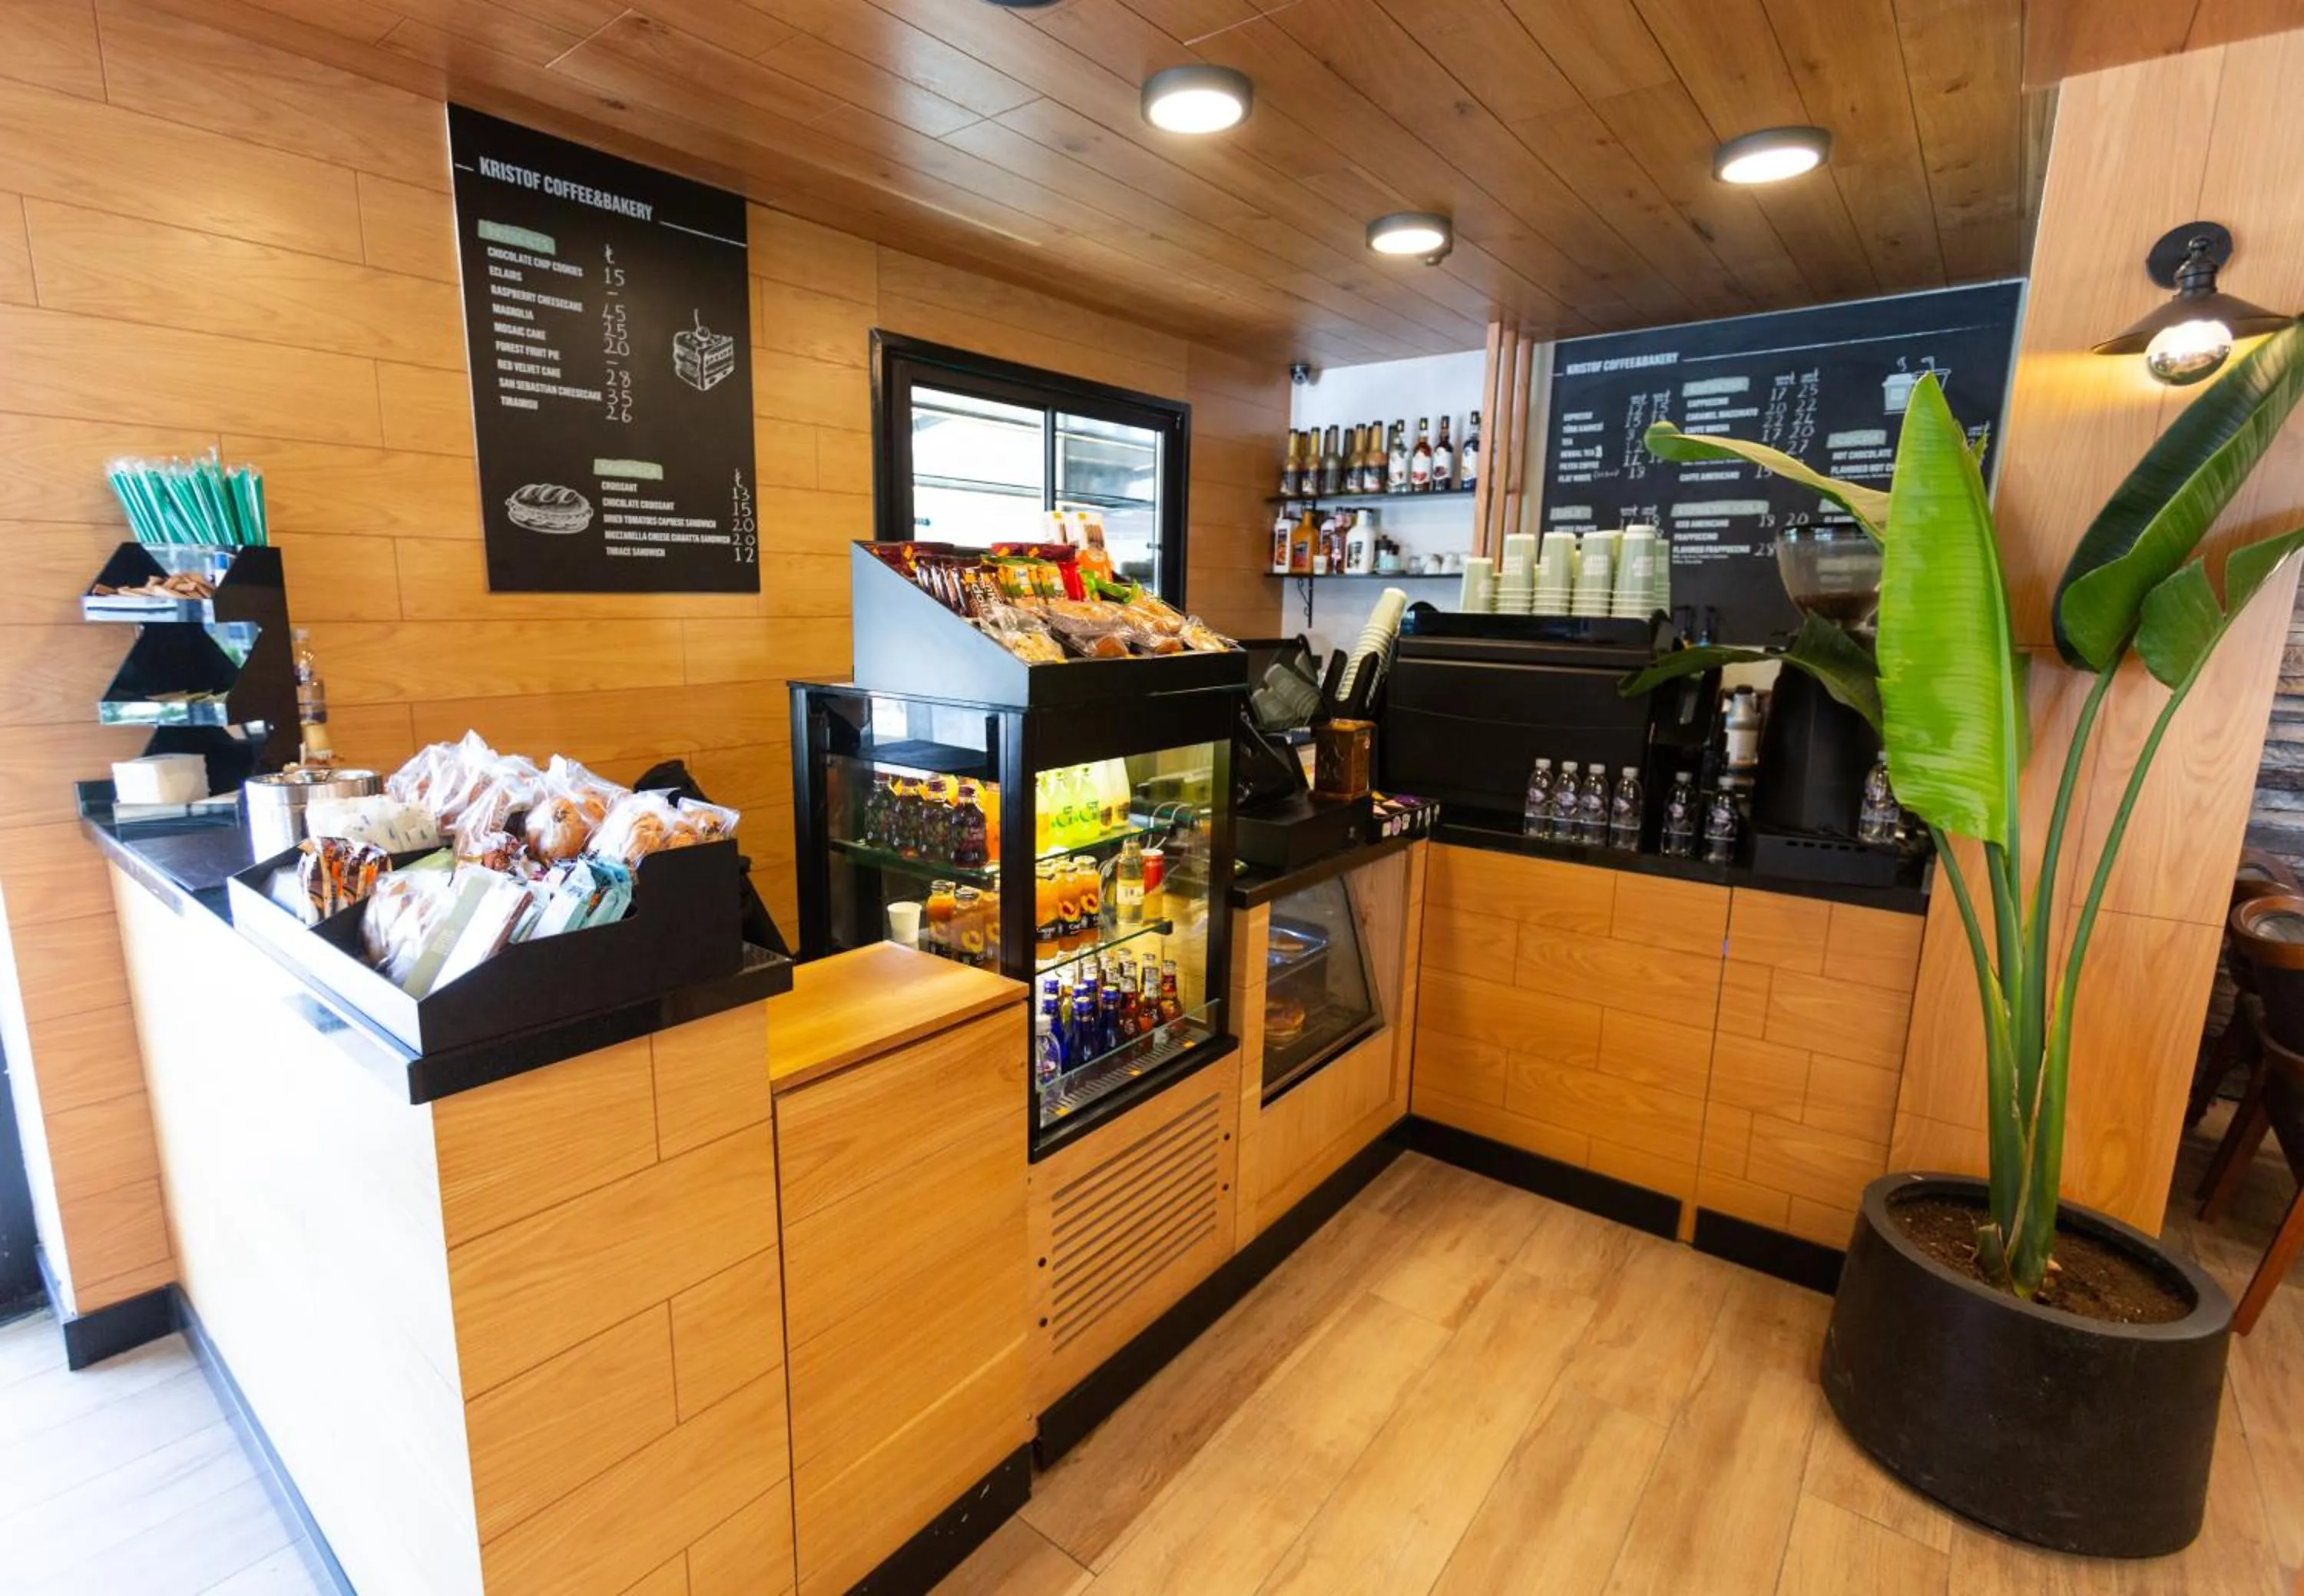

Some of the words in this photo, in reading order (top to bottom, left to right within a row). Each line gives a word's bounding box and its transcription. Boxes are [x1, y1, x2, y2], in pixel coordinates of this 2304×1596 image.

[479, 156, 541, 190] KRISTOF
[544, 176, 652, 221] COFFEE&BAKERY
[488, 247, 533, 267] CHOCOLATE
[534, 257, 551, 270] CHIP
[553, 261, 583, 277] COOKIES
[488, 265, 522, 281] ECLAIRS
[605, 267, 624, 286] 15
[490, 284, 536, 302] RASPBERRY
[538, 294, 582, 313] CHEESECAKE
[492, 303, 534, 320] MAGNOLIA
[494, 322, 525, 336] MOSAIC
[526, 328, 546, 340] CAKE
[604, 321, 627, 340] 25
[495, 340, 525, 354] FOREST
[604, 337, 629, 356] 20
[497, 359, 514, 370] RED
[515, 362, 540, 375] VELVET
[541, 366, 561, 378] CAKE
[1567, 362, 1602, 376] KRISTOF
[1604, 353, 1678, 372] COFFEE&BAKERY
[607, 369, 631, 388] 28
[498, 377, 515, 389] SAN
[516, 379, 558, 394] SEBASTIAN
[558, 386, 602, 401] CHEESECAKE
[1770, 386, 1787, 402] 17
[1797, 384, 1819, 399] 25
[500, 395, 538, 410] TIRAMISU
[606, 388, 632, 408] 35
[1795, 399, 1817, 412] 22
[606, 406, 633, 423] 26
[1789, 425, 1816, 439] 20
[1849, 449, 1892, 460] CHOCOLATE
[601, 480, 637, 492] CROISSANT
[732, 487, 750, 502] 13
[602, 497, 639, 508] CHOCOLATE
[640, 499, 675, 511] CROISSANT
[733, 502, 752, 517] 15
[686, 519, 717, 528] SANDWICH
[733, 518, 755, 533] 20
[1785, 512, 1809, 526] 20
[732, 534, 756, 545] 20
[633, 548, 666, 558] SANDWICH
[734, 548, 754, 563] 12
